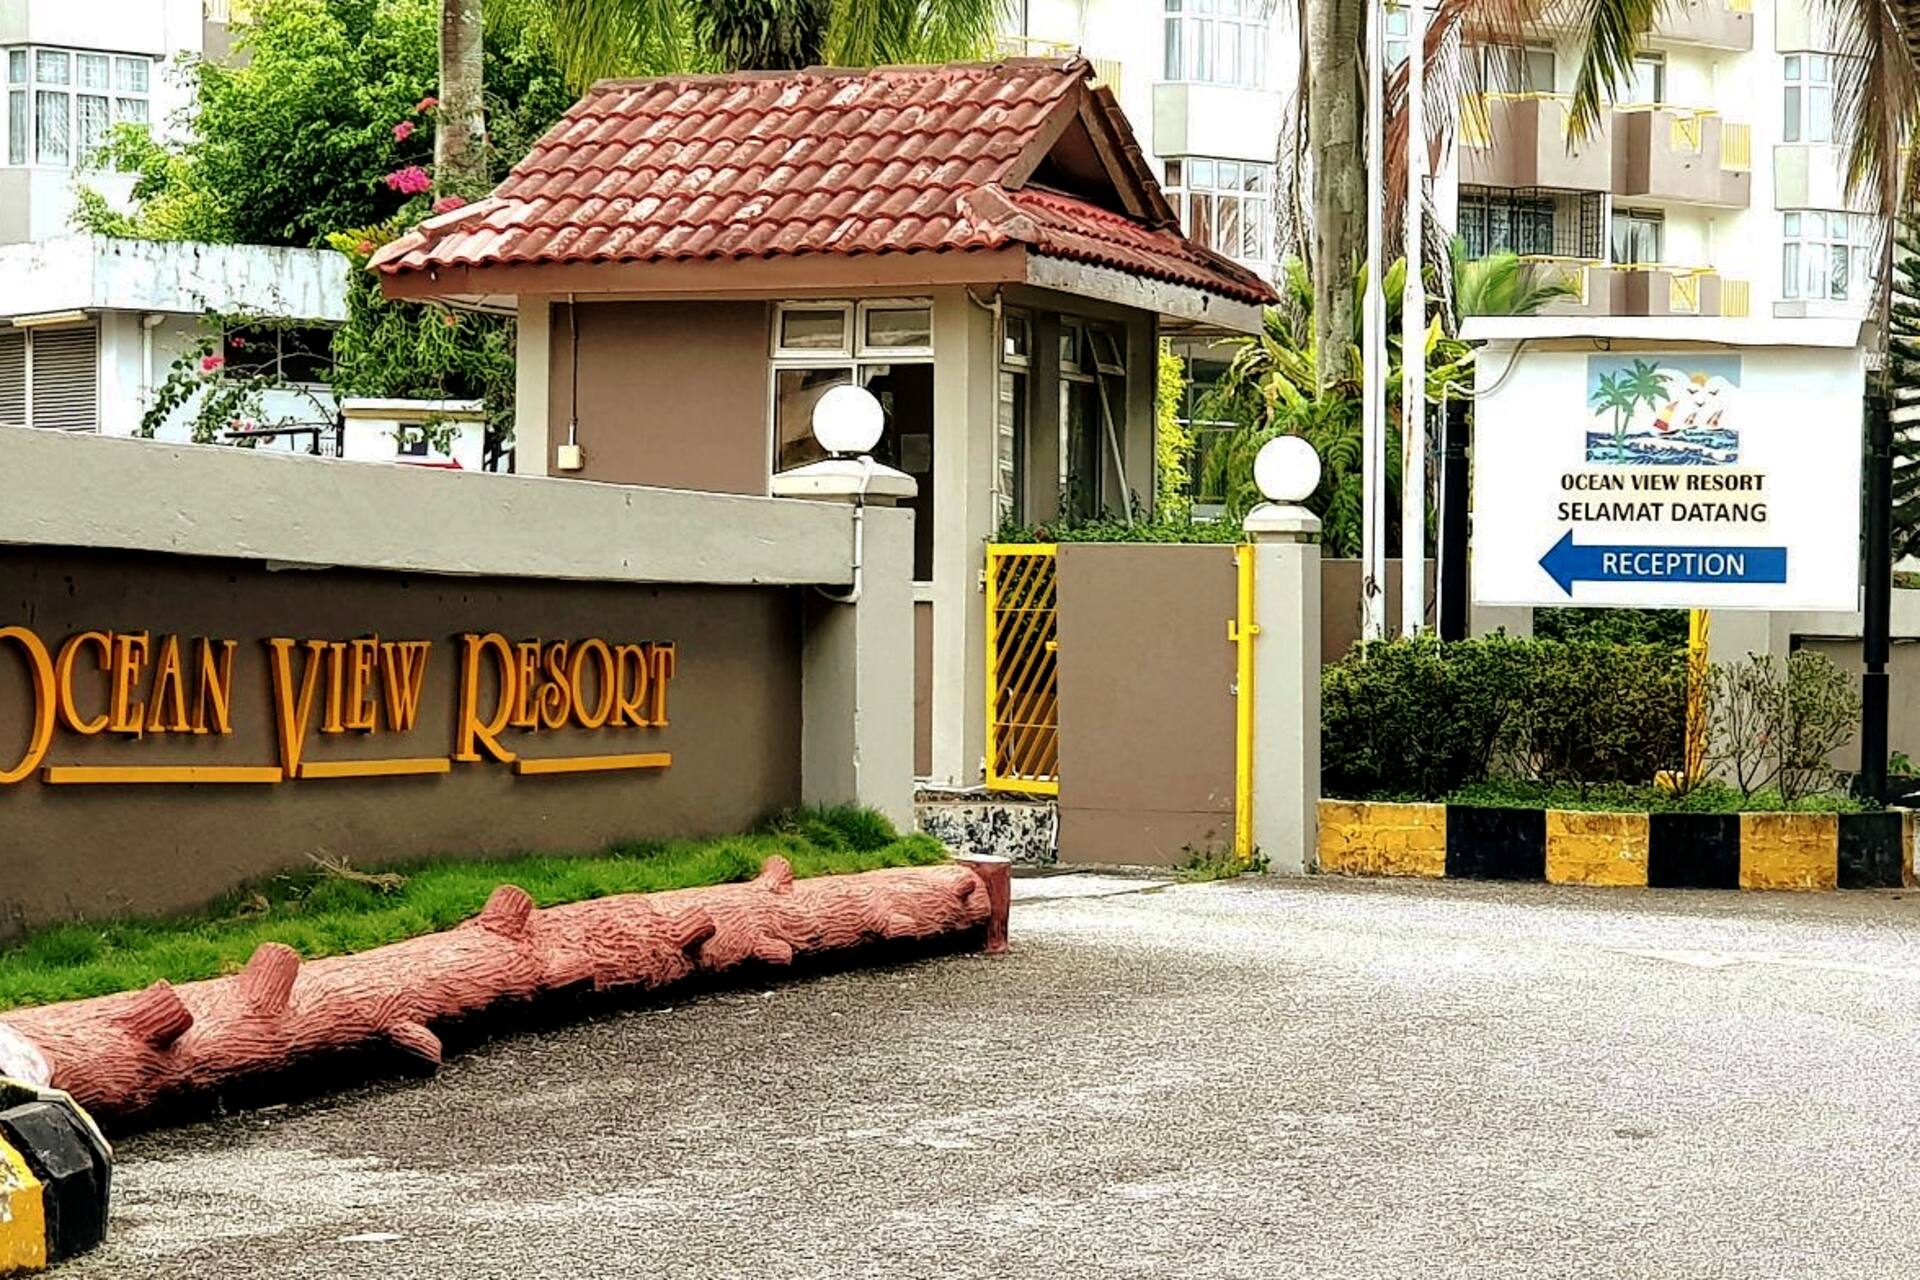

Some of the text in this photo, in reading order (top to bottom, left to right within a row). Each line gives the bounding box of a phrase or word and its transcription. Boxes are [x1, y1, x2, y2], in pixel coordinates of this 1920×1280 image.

[403, 427, 425, 452] P
[1560, 473, 1767, 491] OCEAN VIEW RESORT
[1557, 502, 1768, 522] SELAMAT DATANG
[1602, 552, 1745, 576] RECEPTION
[266, 634, 432, 778] VIEW
[453, 632, 676, 763] RESORT
